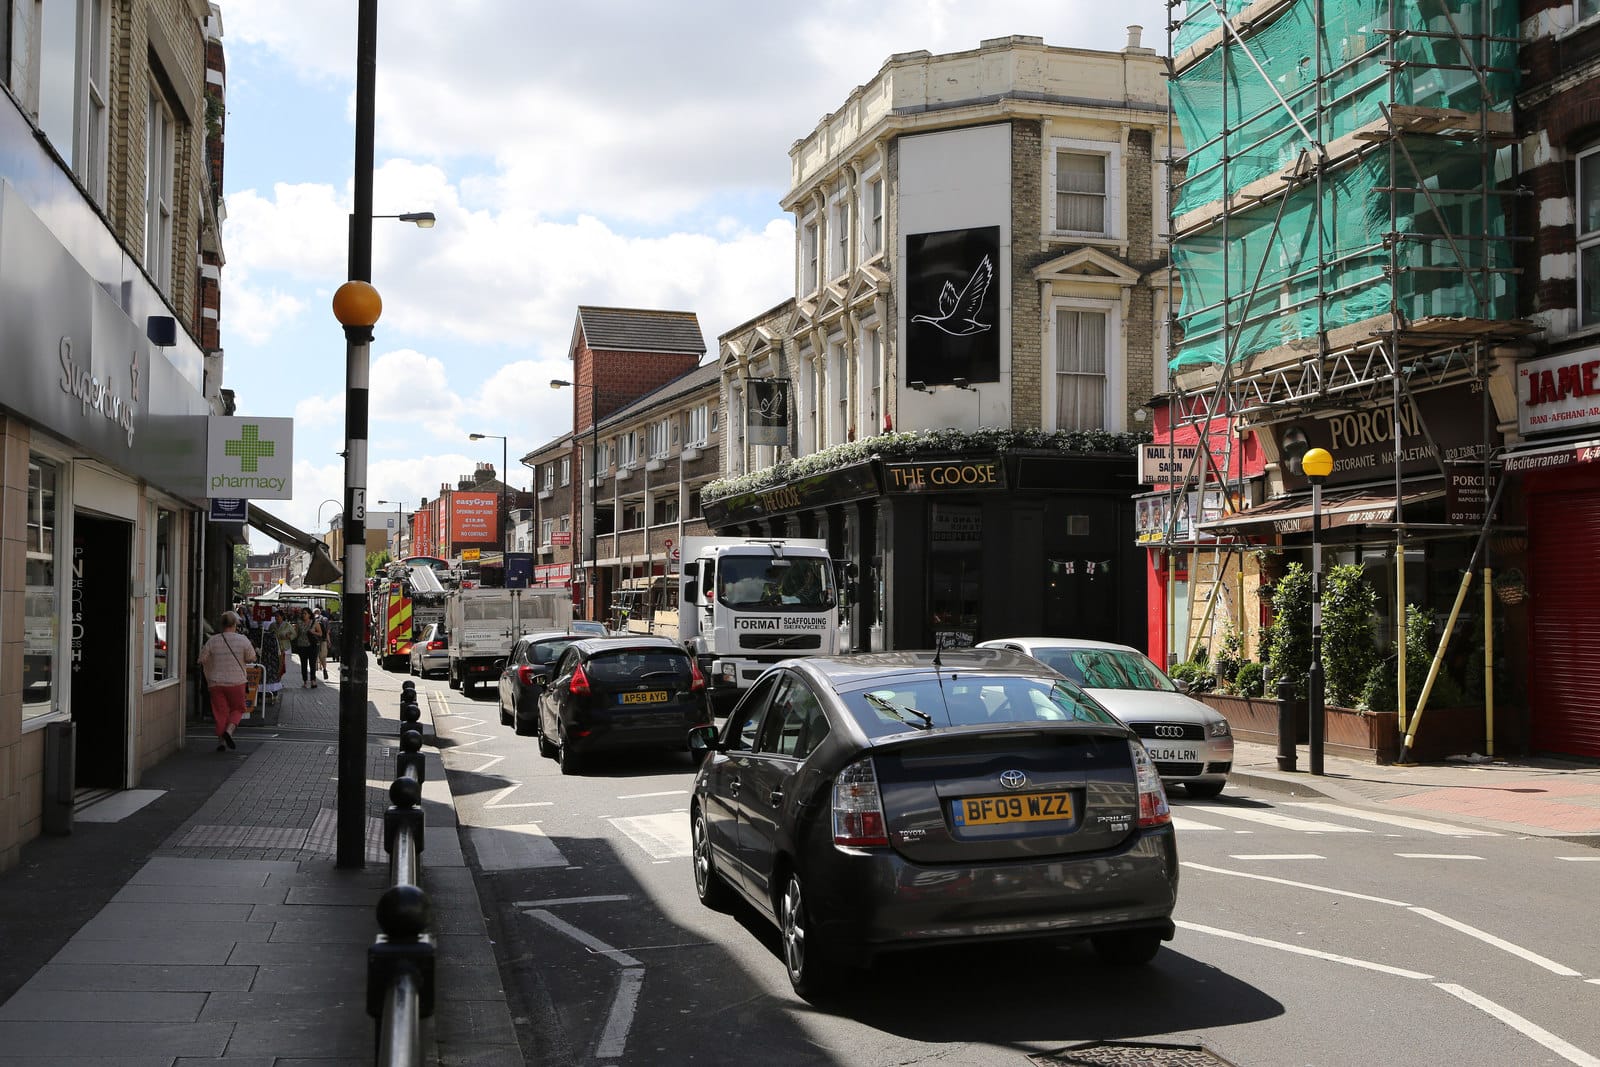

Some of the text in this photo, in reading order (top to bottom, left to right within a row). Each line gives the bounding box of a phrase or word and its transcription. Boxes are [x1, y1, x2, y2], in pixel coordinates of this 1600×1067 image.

[60, 336, 135, 448] Superdrug
[1530, 414, 1548, 425] IRANI
[1552, 409, 1585, 421] AFGHANI
[1329, 403, 1420, 449] PORCINI
[1147, 447, 1165, 459] NAIL
[1177, 447, 1195, 459] TAN
[1332, 454, 1376, 472] ISTORANTE
[1505, 453, 1570, 471] Mediterranean
[890, 465, 996, 486] THE GOOSE
[211, 474, 286, 491] pharmacy
[456, 498, 494, 506] easyGym
[1274, 519, 1300, 532] PORCINI
[734, 616, 781, 629] FORMAT
[783, 617, 827, 625] SCAFFOLDING
[624, 691, 666, 703] AP58 AYG
[1150, 749, 1196, 760] SL04 LRN
[966, 795, 1069, 820] BF09 WZZ
[1097, 814, 1132, 823] PRIUS
[899, 829, 927, 837] TOYOTA
